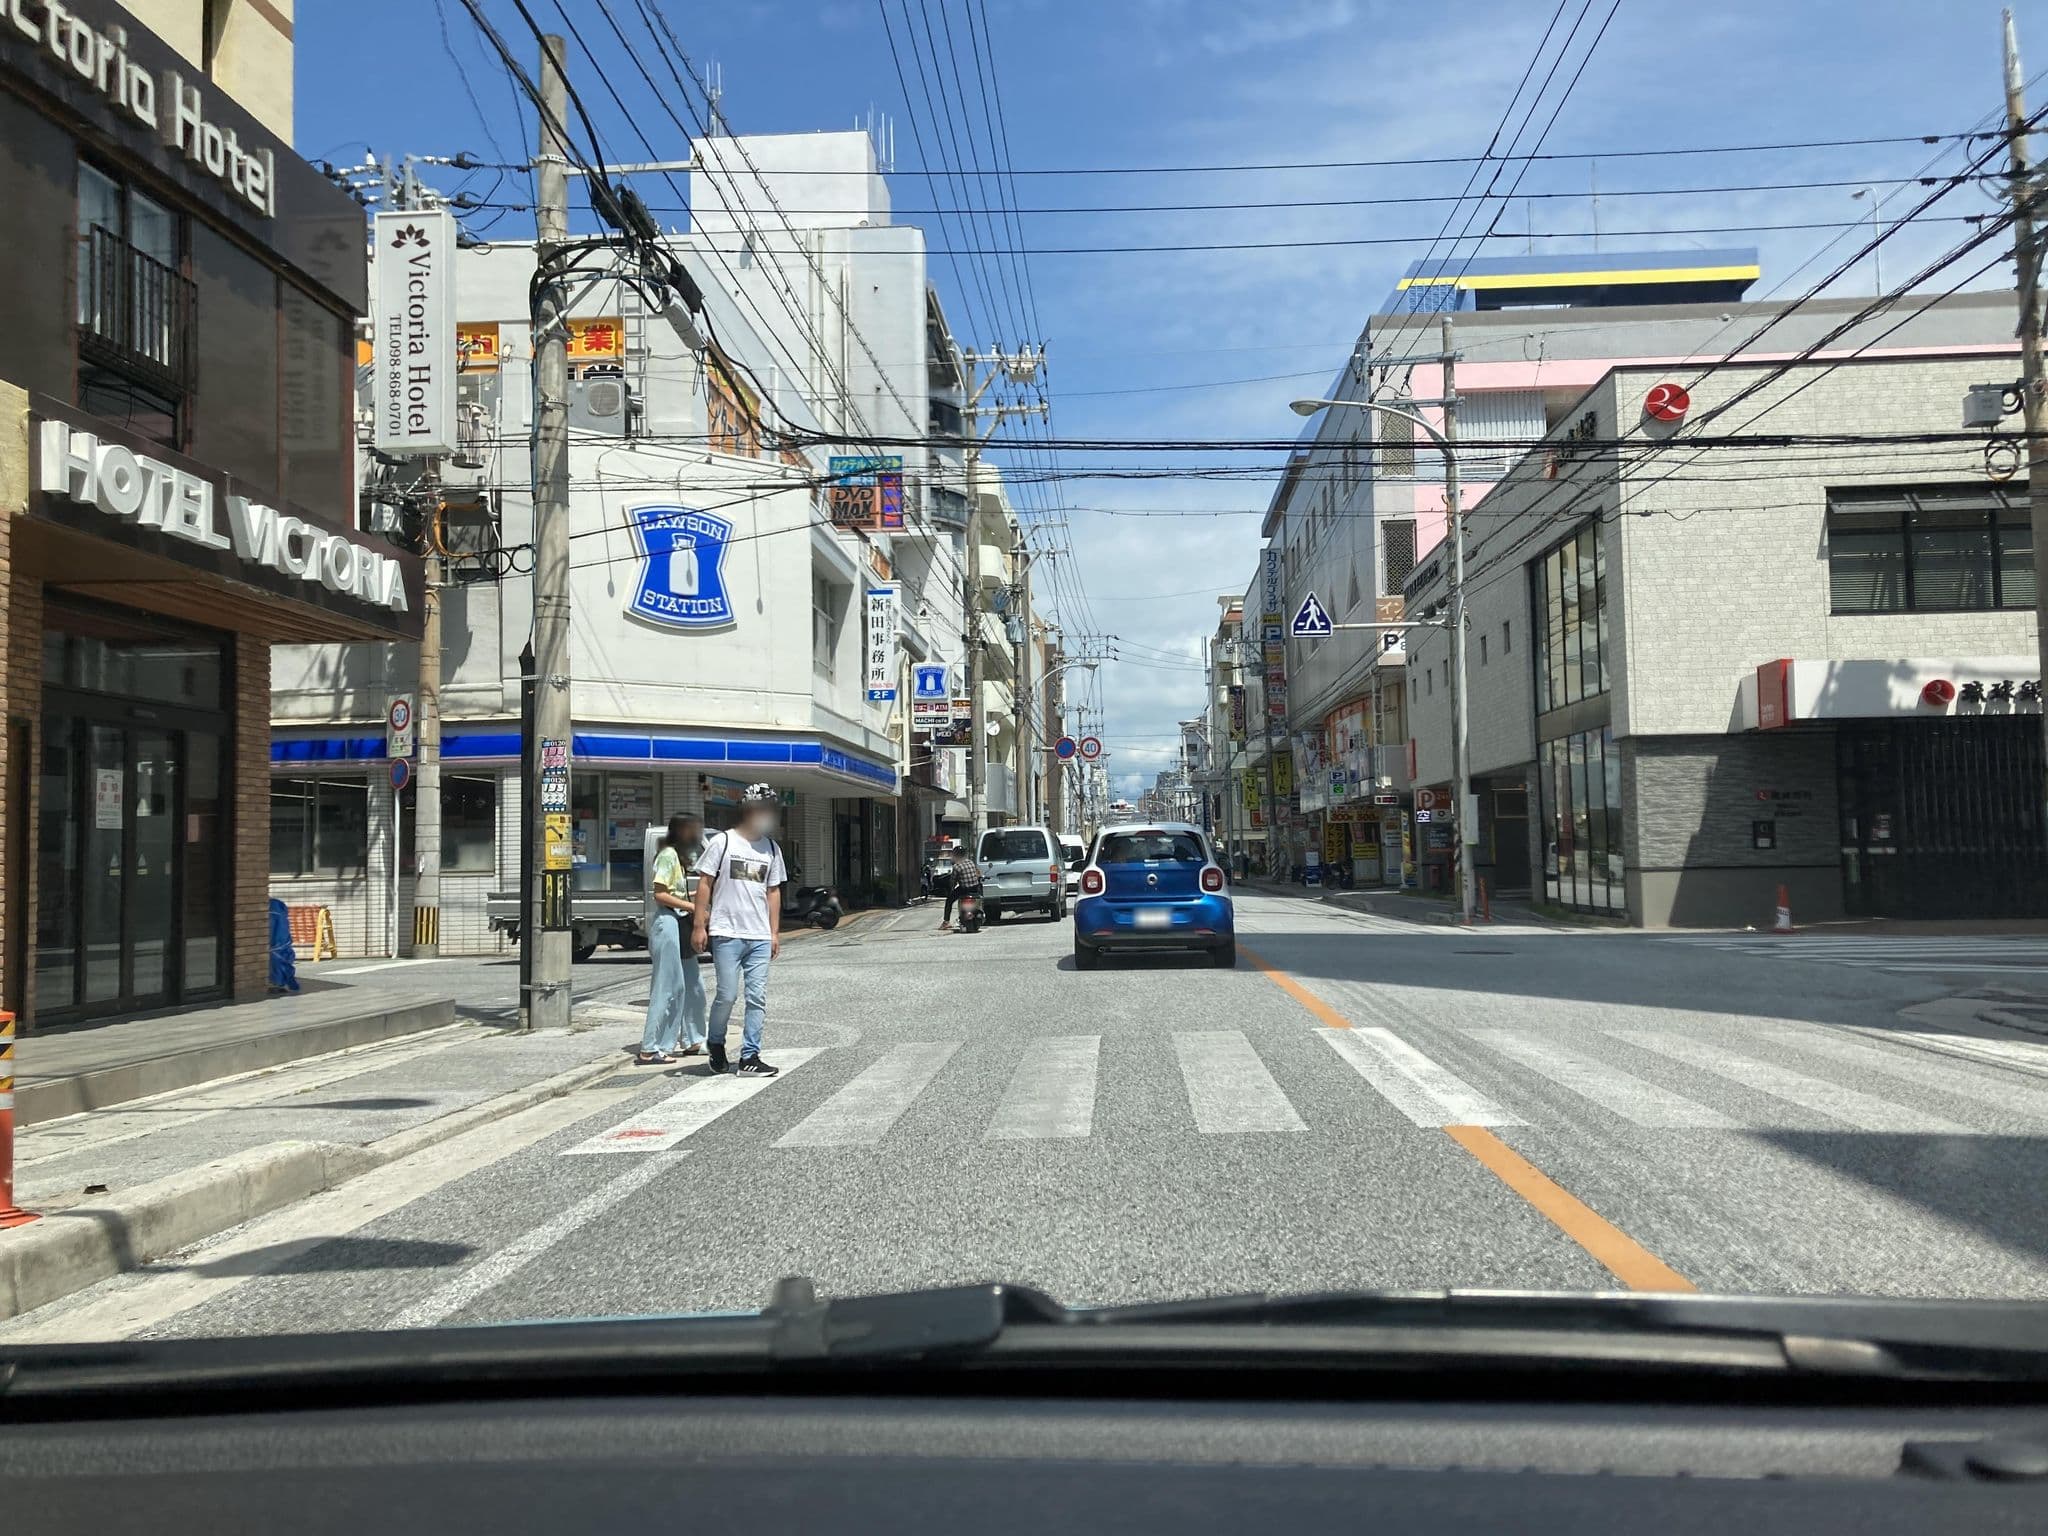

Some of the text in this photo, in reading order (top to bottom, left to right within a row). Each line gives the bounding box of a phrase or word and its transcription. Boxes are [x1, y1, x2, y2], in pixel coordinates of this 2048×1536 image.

[0, 0, 276, 219] ctoria Hotel
[408, 251, 432, 437] Victoria Hotel
[835, 487, 874, 501] DVD
[41, 420, 409, 612] HOTEL VICTORIA
[833, 501, 873, 519] MAX
[641, 513, 725, 541] LAWSON
[642, 588, 724, 615] STATION
[871, 598, 885, 681] 新田事務所
[873, 690, 889, 699] 2F
[394, 708, 406, 722] 30
[935, 703, 948, 712] ATM
[1085, 743, 1096, 753] 40
[543, 784, 565, 792] 195
[1416, 809, 1431, 823] 空
